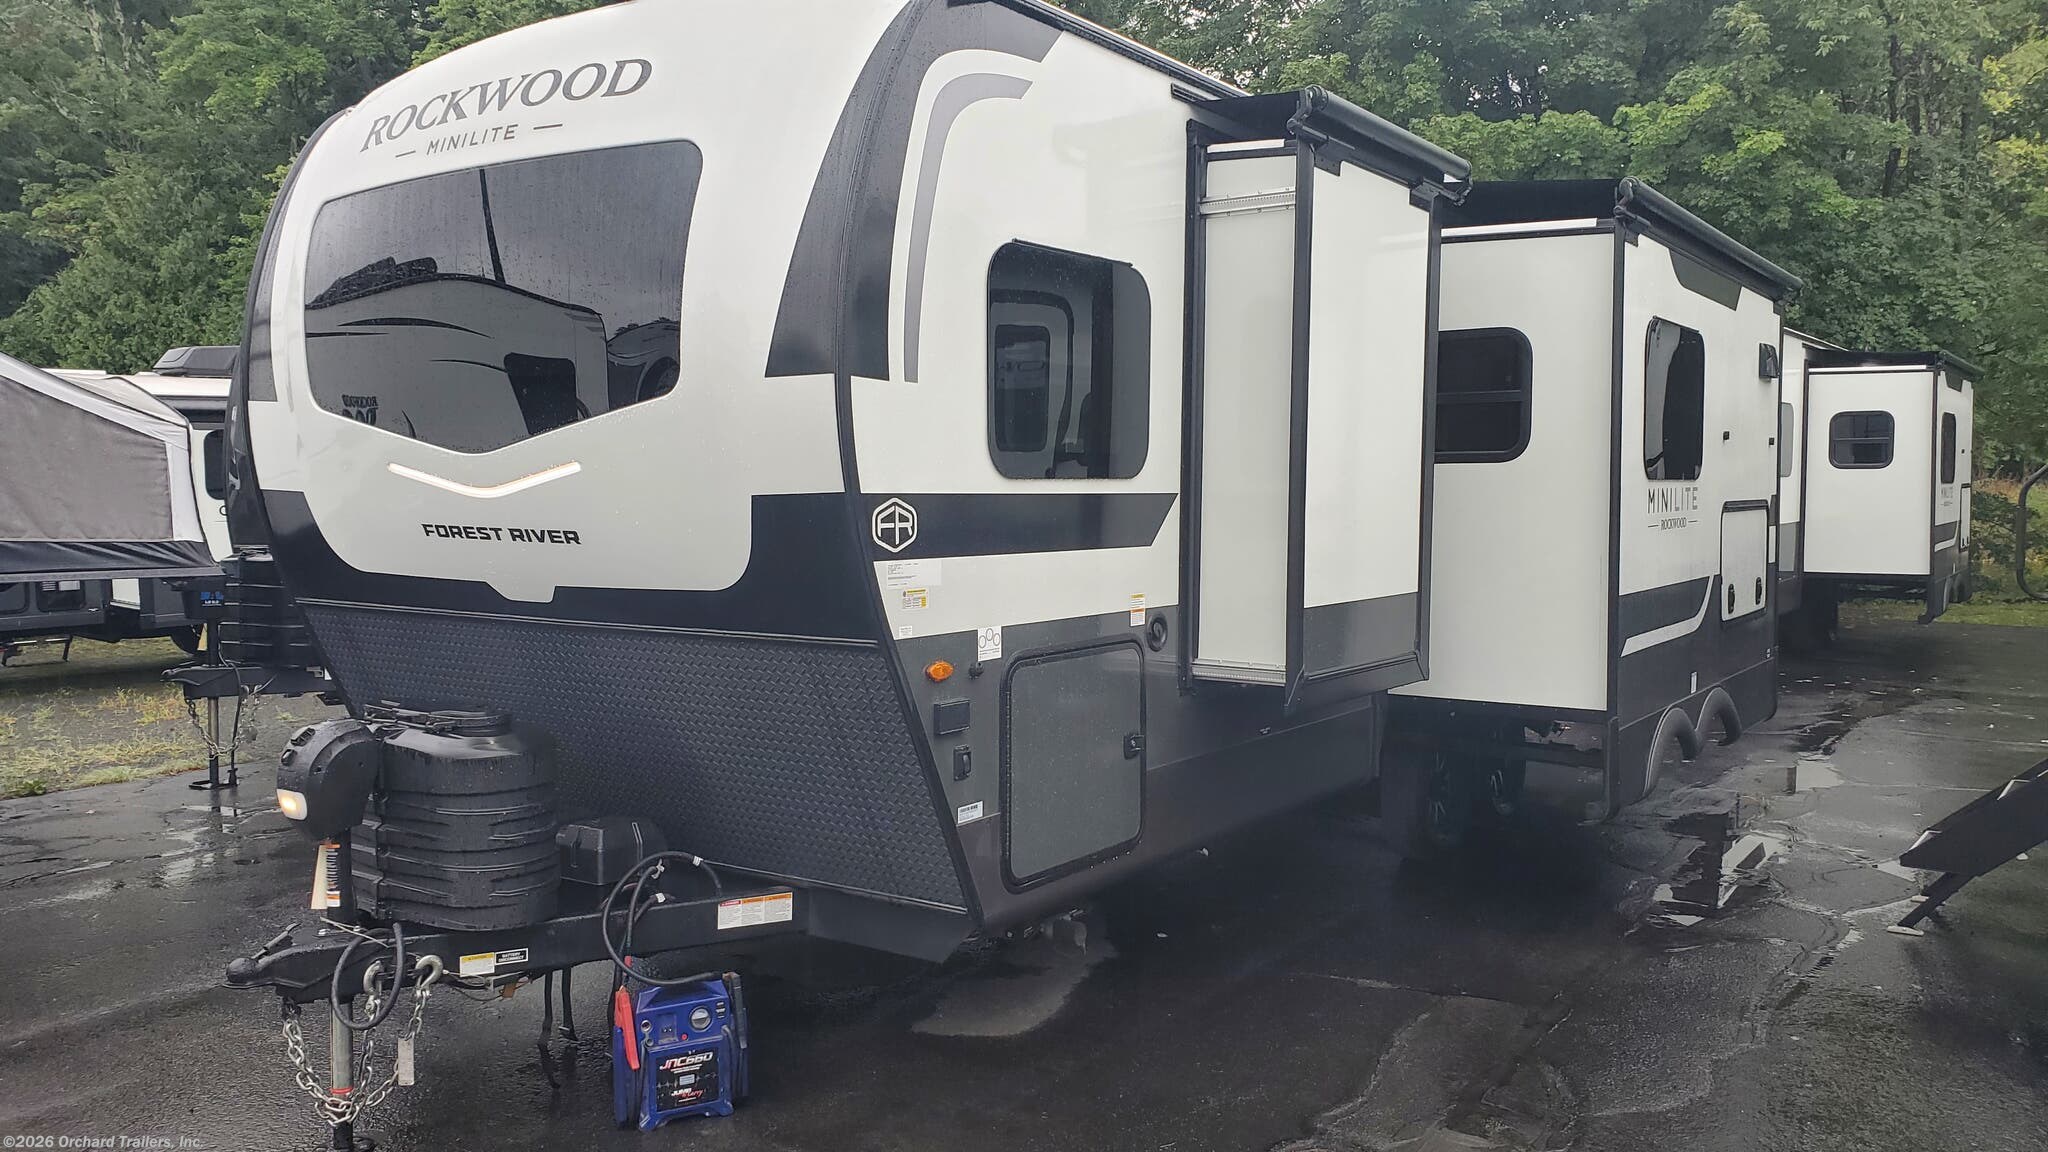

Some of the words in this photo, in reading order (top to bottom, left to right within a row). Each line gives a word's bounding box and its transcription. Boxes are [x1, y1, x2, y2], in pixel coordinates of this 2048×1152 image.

[360, 58, 653, 153] ROCKWOOD
[426, 123, 519, 155] MINILITE
[1647, 486, 1699, 514] MINILITE
[421, 523, 503, 541] FOREST
[507, 528, 582, 545] RIVER
[1660, 517, 1687, 531] ROCKWOOD
[659, 1051, 714, 1071] JNC660
